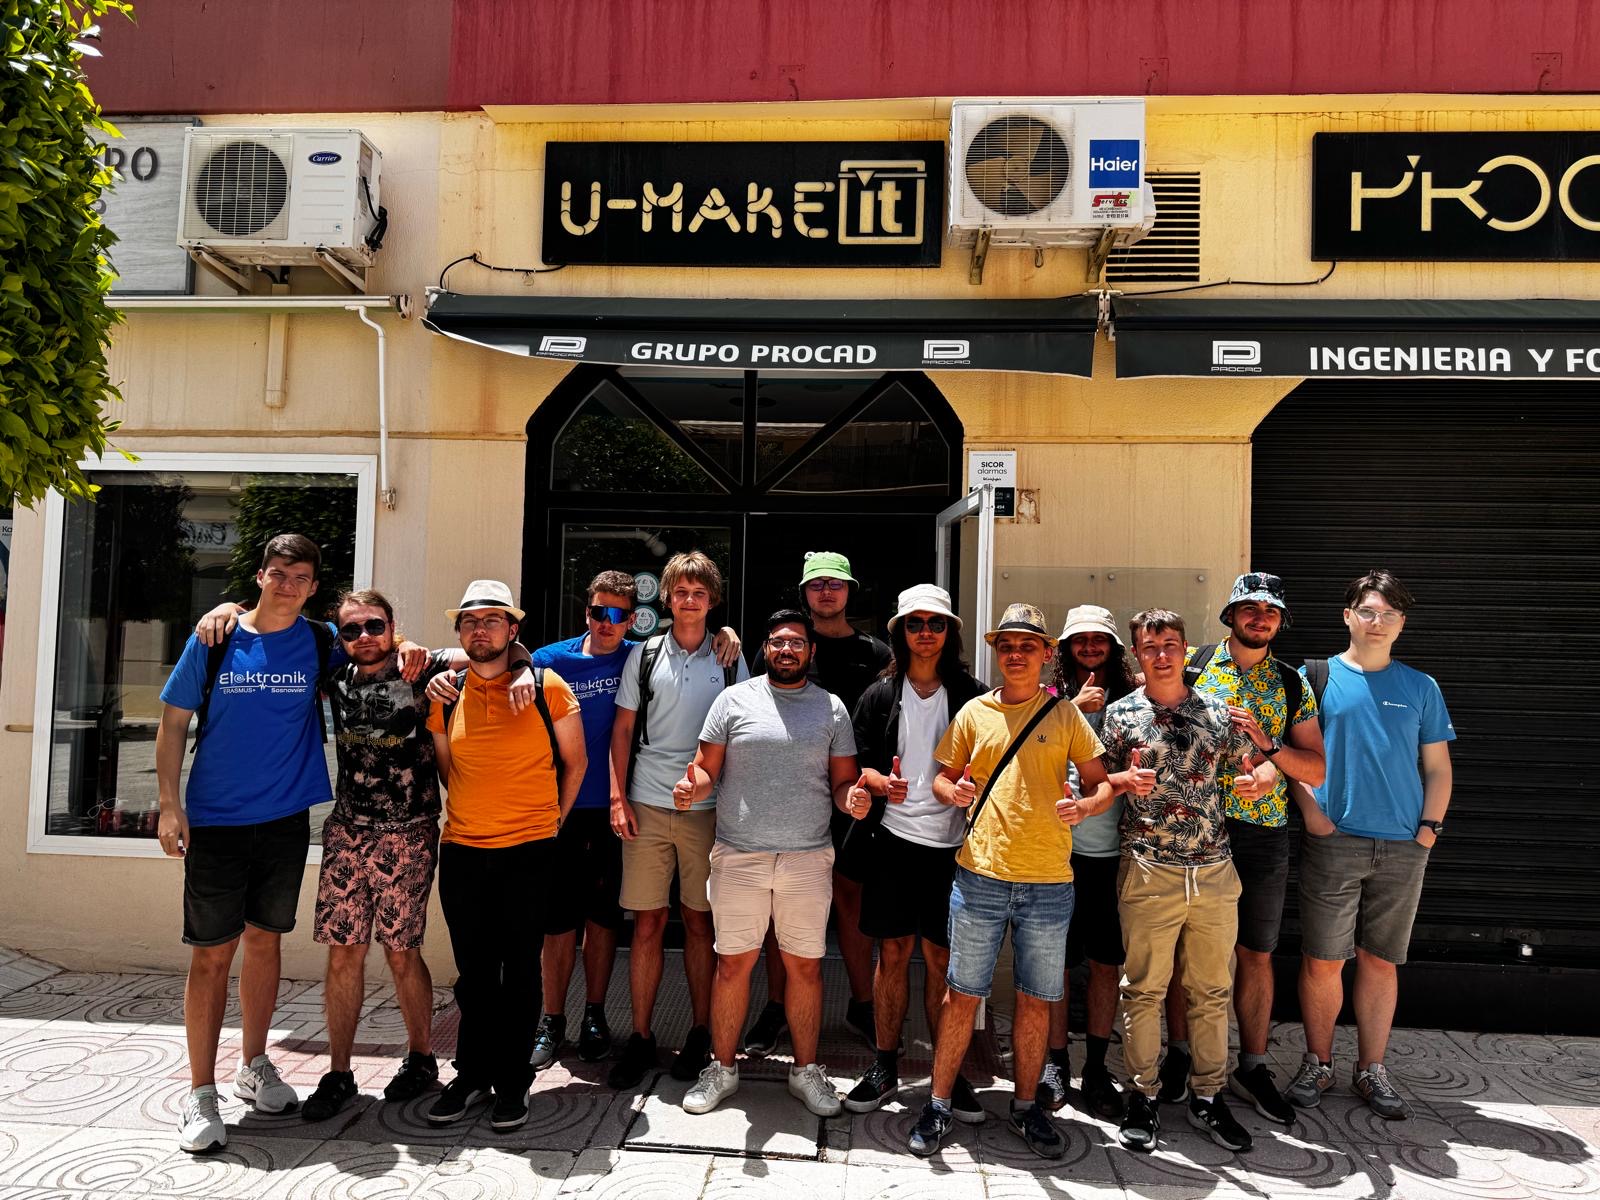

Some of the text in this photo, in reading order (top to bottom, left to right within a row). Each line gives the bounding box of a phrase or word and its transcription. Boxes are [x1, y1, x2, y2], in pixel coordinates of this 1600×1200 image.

[1091, 156, 1137, 171] Haier
[560, 181, 835, 239] U-MAKE
[855, 170, 903, 234] it
[631, 342, 877, 364] GRUPO PROCAD
[1309, 346, 1511, 372] INGENIERIA
[1527, 348, 1554, 373] Y
[219, 671, 306, 684] Elektronik
